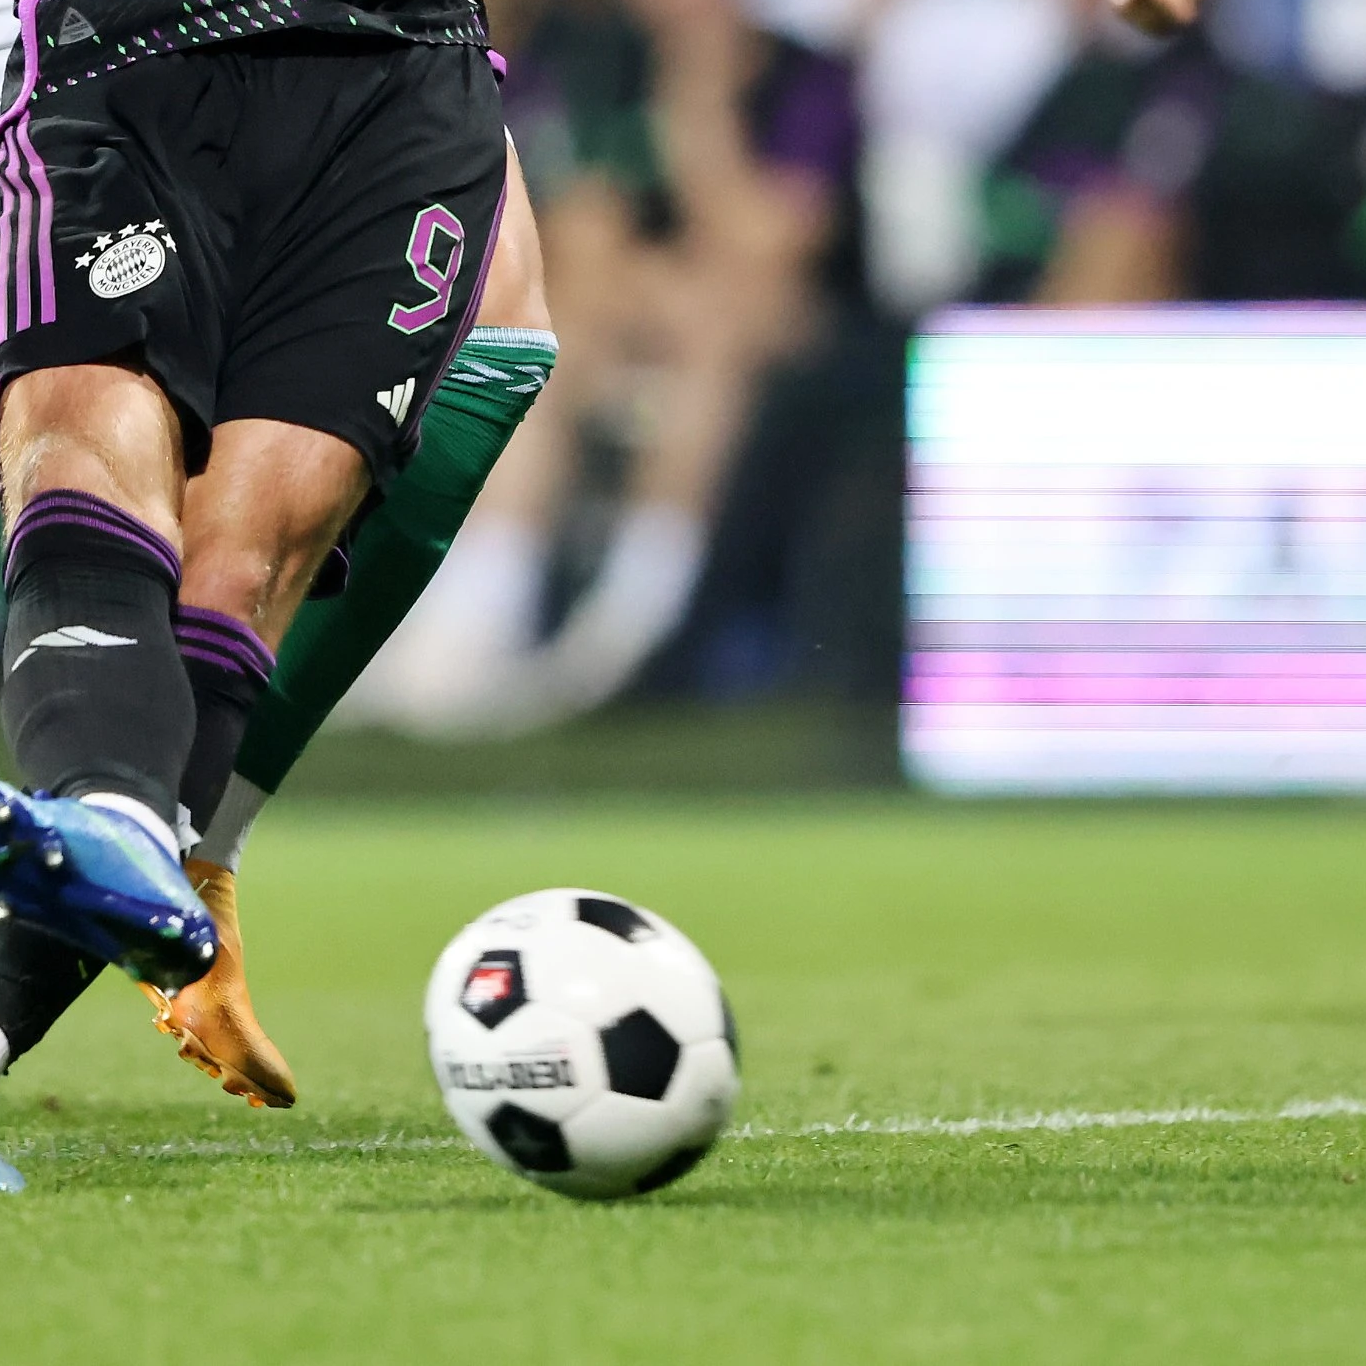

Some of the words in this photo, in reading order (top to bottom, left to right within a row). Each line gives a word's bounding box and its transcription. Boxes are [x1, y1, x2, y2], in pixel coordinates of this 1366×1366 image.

[96, 257, 111, 270] FC
[112, 239, 157, 255] BAYERN
[387, 203, 465, 335] 9
